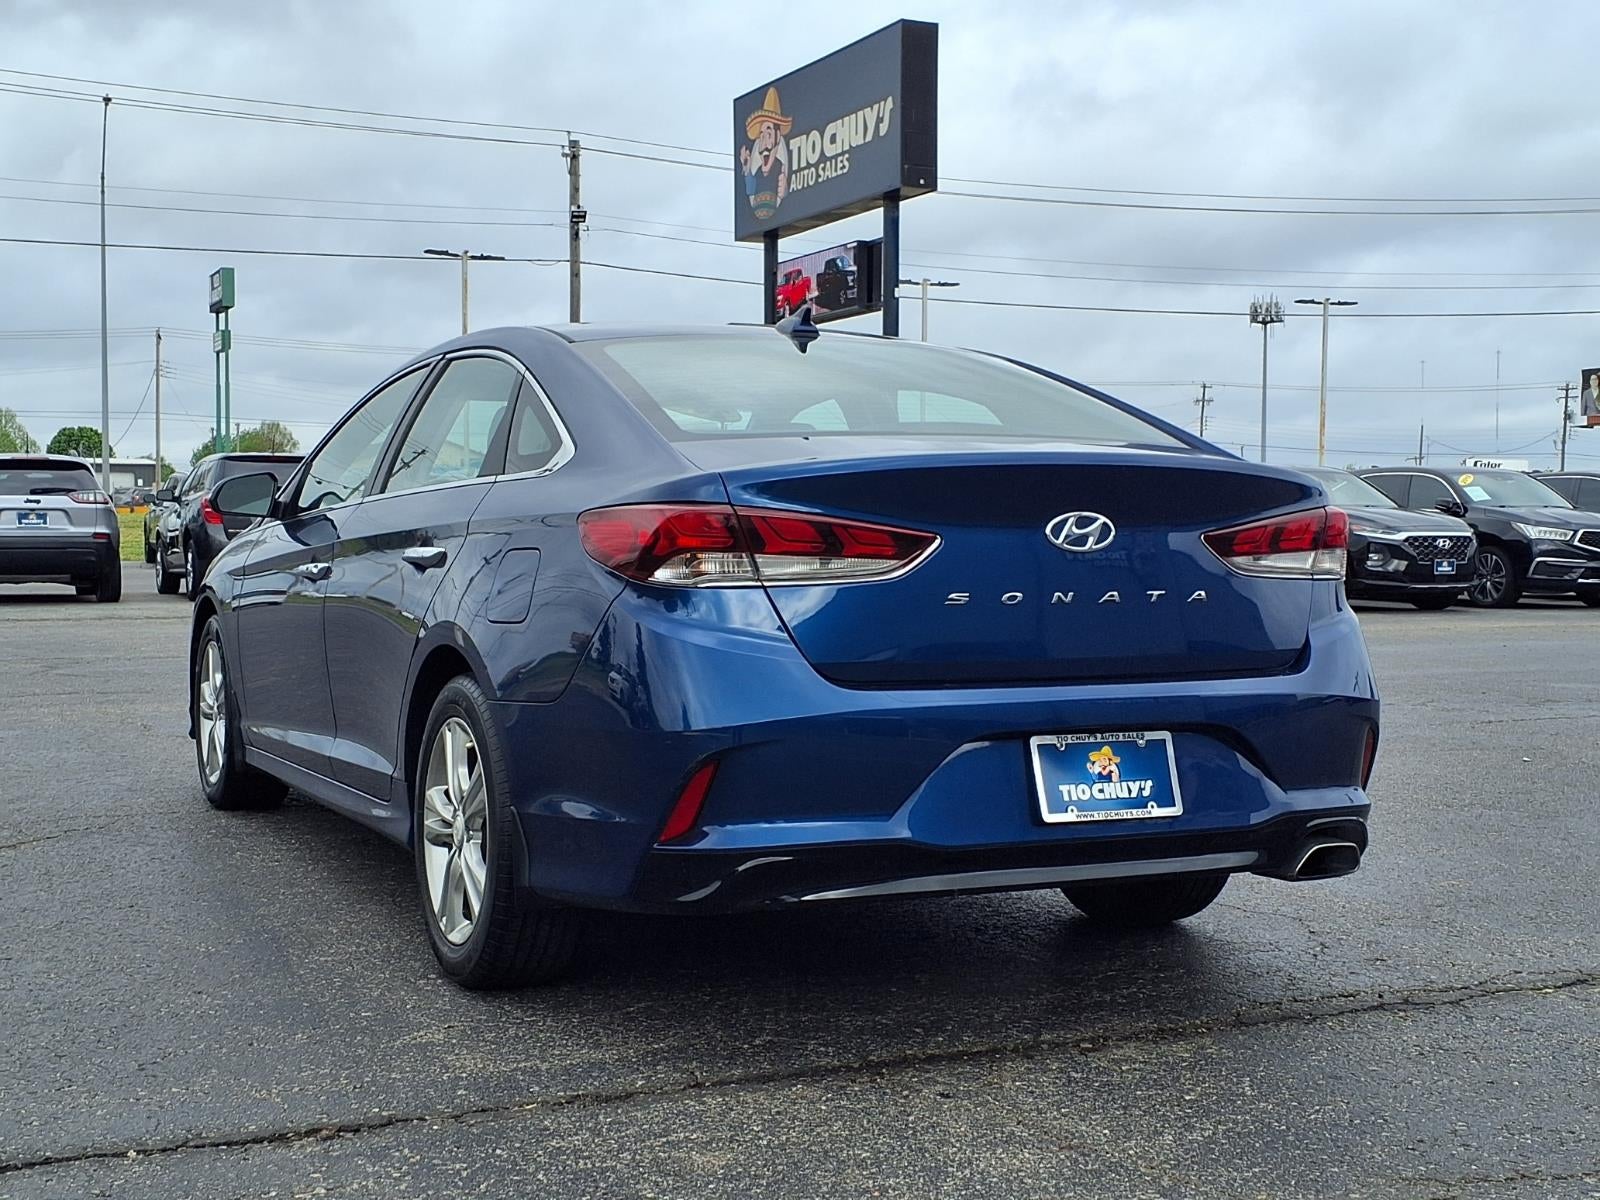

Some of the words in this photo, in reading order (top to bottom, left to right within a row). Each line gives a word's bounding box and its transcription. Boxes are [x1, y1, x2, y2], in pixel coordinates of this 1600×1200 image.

[789, 130, 822, 171] TIO
[823, 96, 893, 157] CHUY'S
[789, 167, 816, 193] AUTO
[818, 154, 850, 182] SALES
[944, 591, 1207, 604] SONATA
[1056, 735, 1069, 743] TIO
[1100, 733, 1120, 741] AUTO
[1122, 732, 1146, 740] SALES
[1058, 783, 1091, 801] TIO
[1092, 780, 1153, 800] CHUY'S
[1075, 809, 1153, 820] WWW.TIOCHUYS.COM
